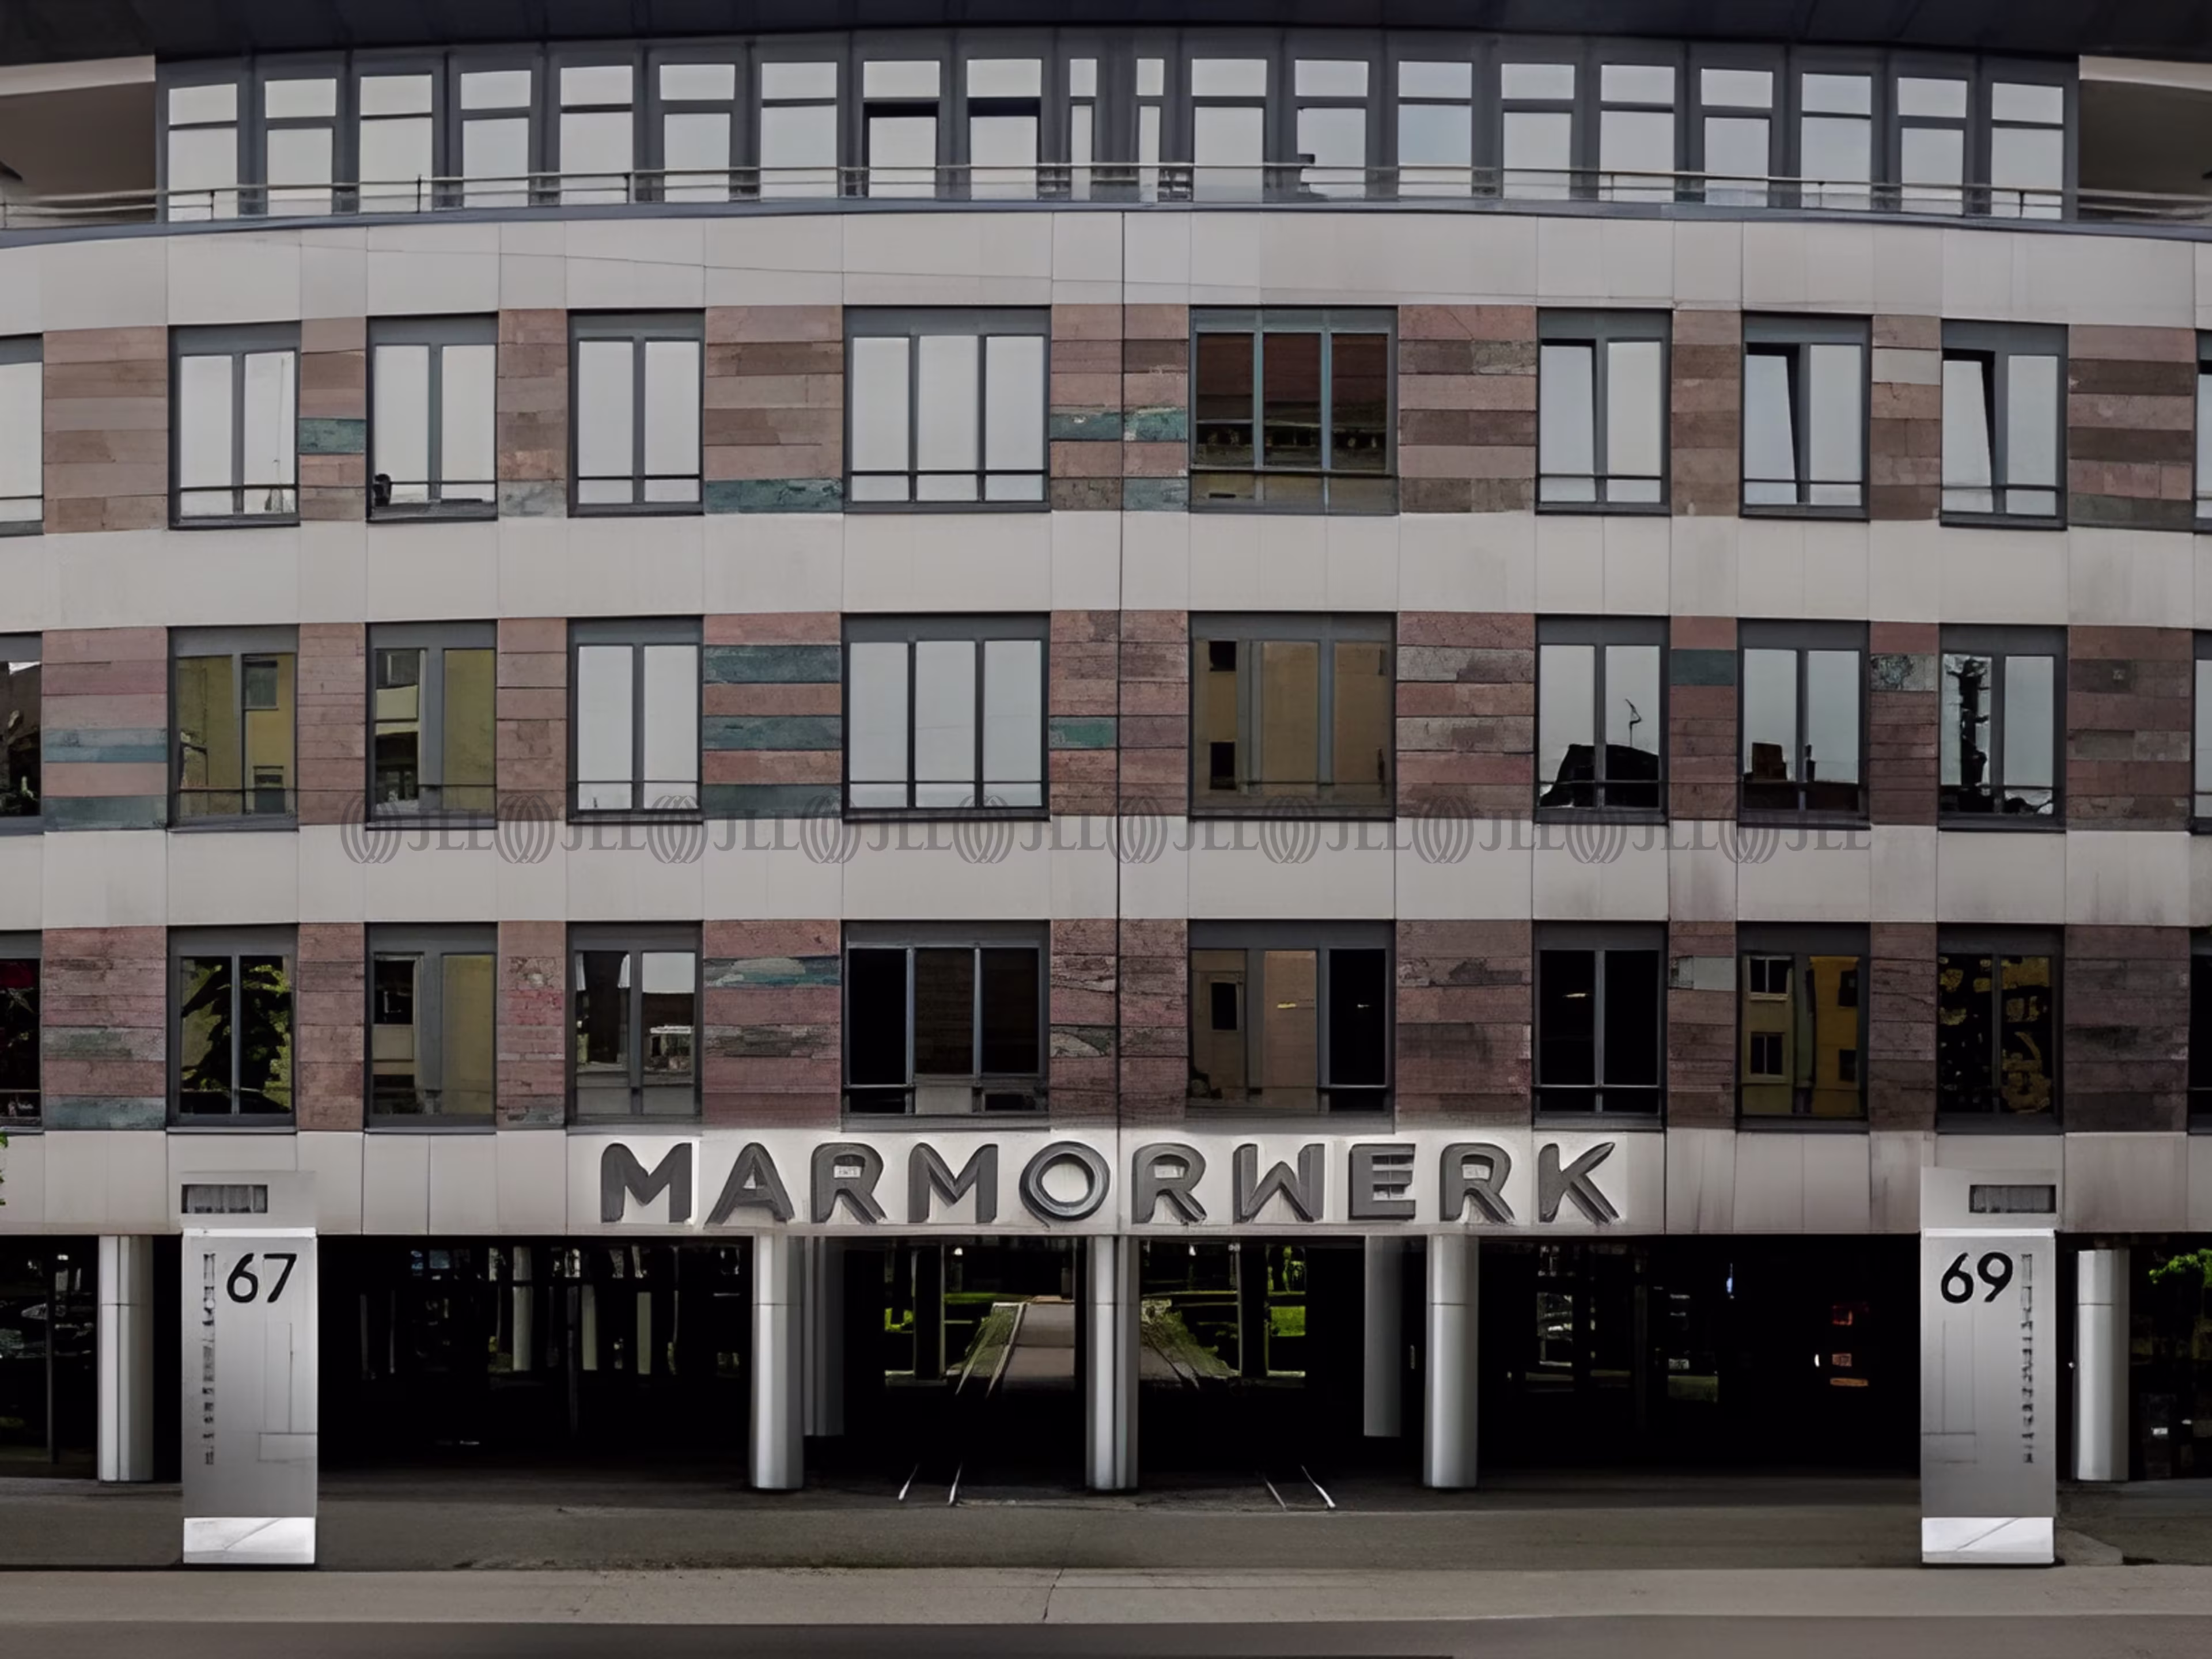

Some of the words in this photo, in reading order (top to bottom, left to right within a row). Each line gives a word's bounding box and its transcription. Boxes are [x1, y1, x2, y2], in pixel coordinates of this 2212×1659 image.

[601, 1141, 1622, 1226] MARMORWERK
[226, 1252, 297, 1303] 67
[1941, 1251, 2013, 1304] 69
